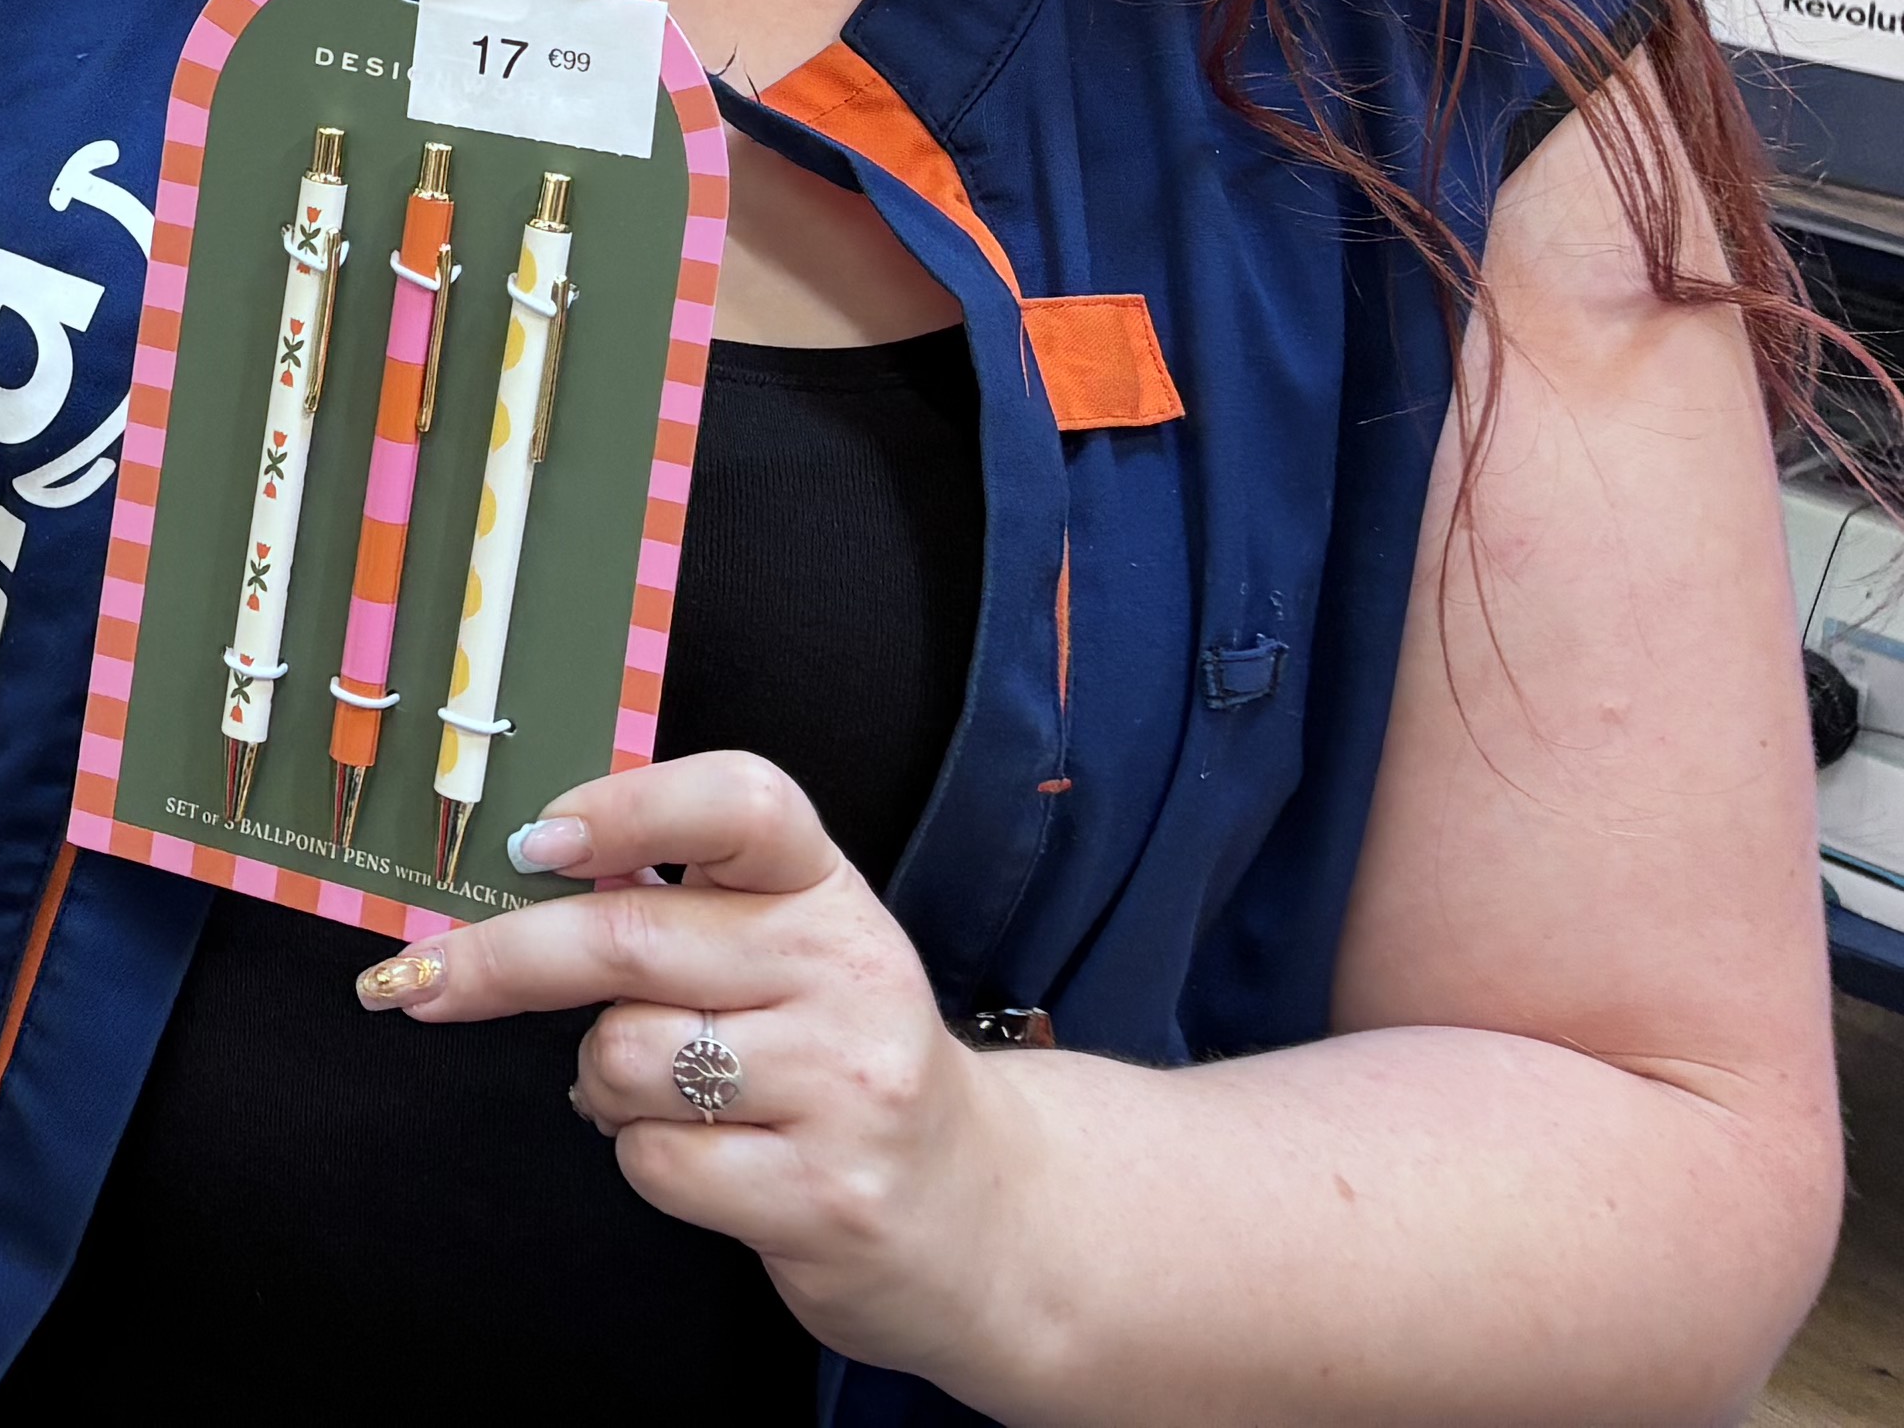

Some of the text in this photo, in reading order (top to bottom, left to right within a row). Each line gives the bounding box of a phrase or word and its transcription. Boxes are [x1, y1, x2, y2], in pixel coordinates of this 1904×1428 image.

[314, 45, 416, 82] DESI
[473, 34, 592, 79] 17 €99
[165, 796, 200, 820] SET
[239, 817, 340, 861] BALLPOINT
[343, 846, 391, 875] PENS
[395, 864, 433, 888] WITH
[435, 877, 498, 907] BLACK
